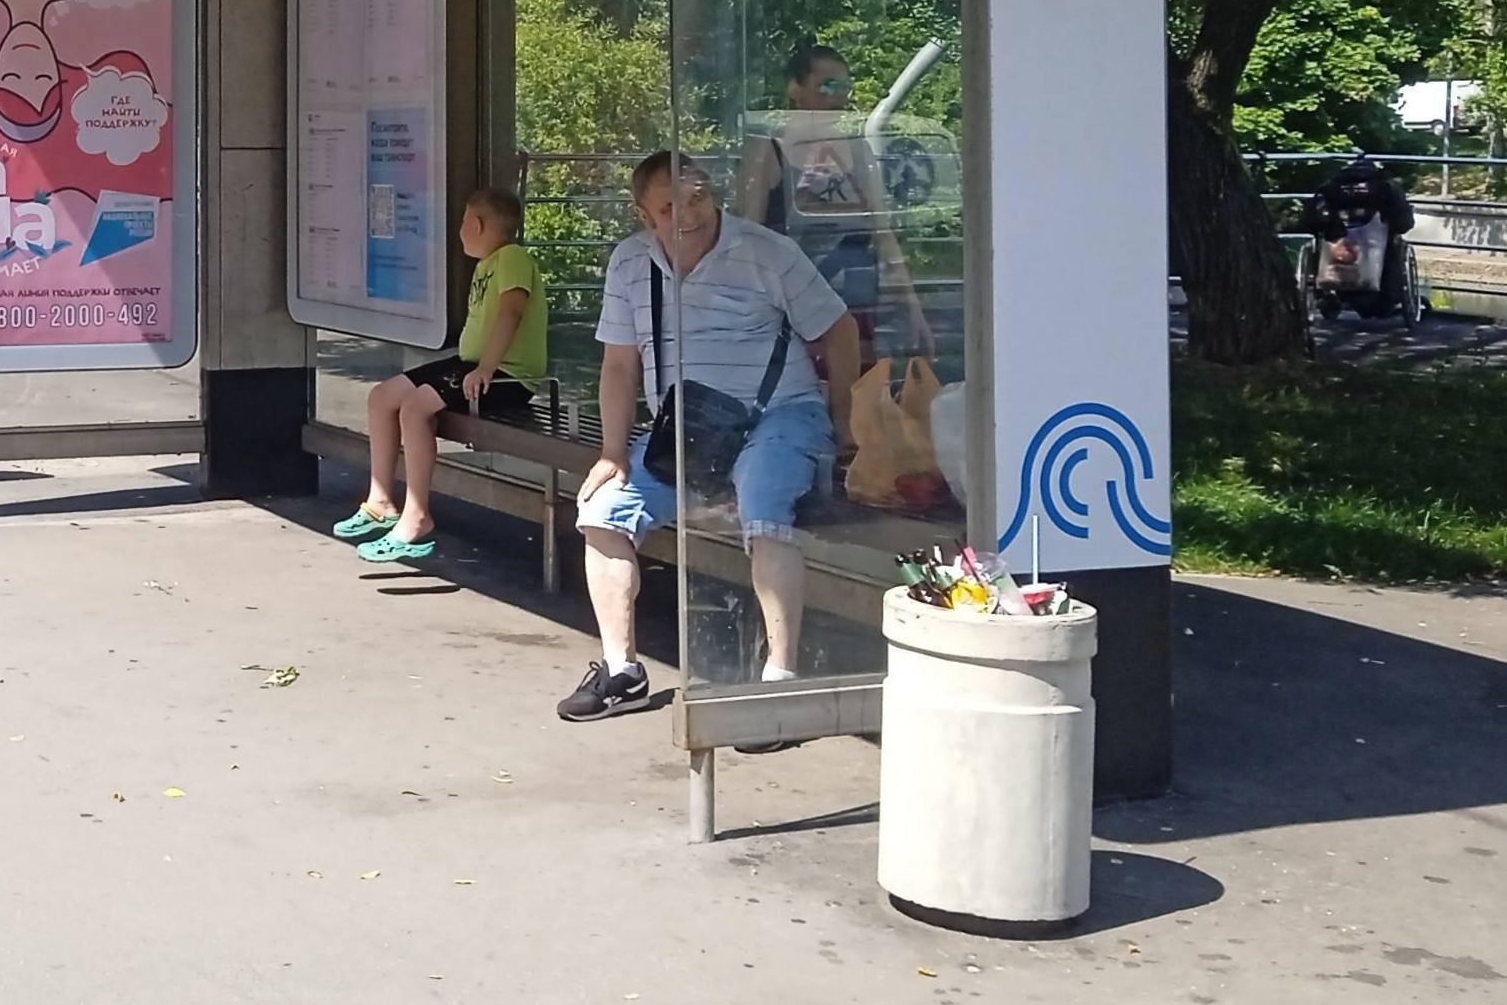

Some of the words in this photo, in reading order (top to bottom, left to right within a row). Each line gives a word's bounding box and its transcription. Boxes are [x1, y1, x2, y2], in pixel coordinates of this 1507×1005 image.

[110, 95, 131, 105] ГДЕ
[85, 119, 158, 129] ПОДДЕРЖКУ?
[52, 288, 111, 298] ПОДДЕРЖКИ
[112, 287, 161, 297] ОТВЕЧАЕТ
